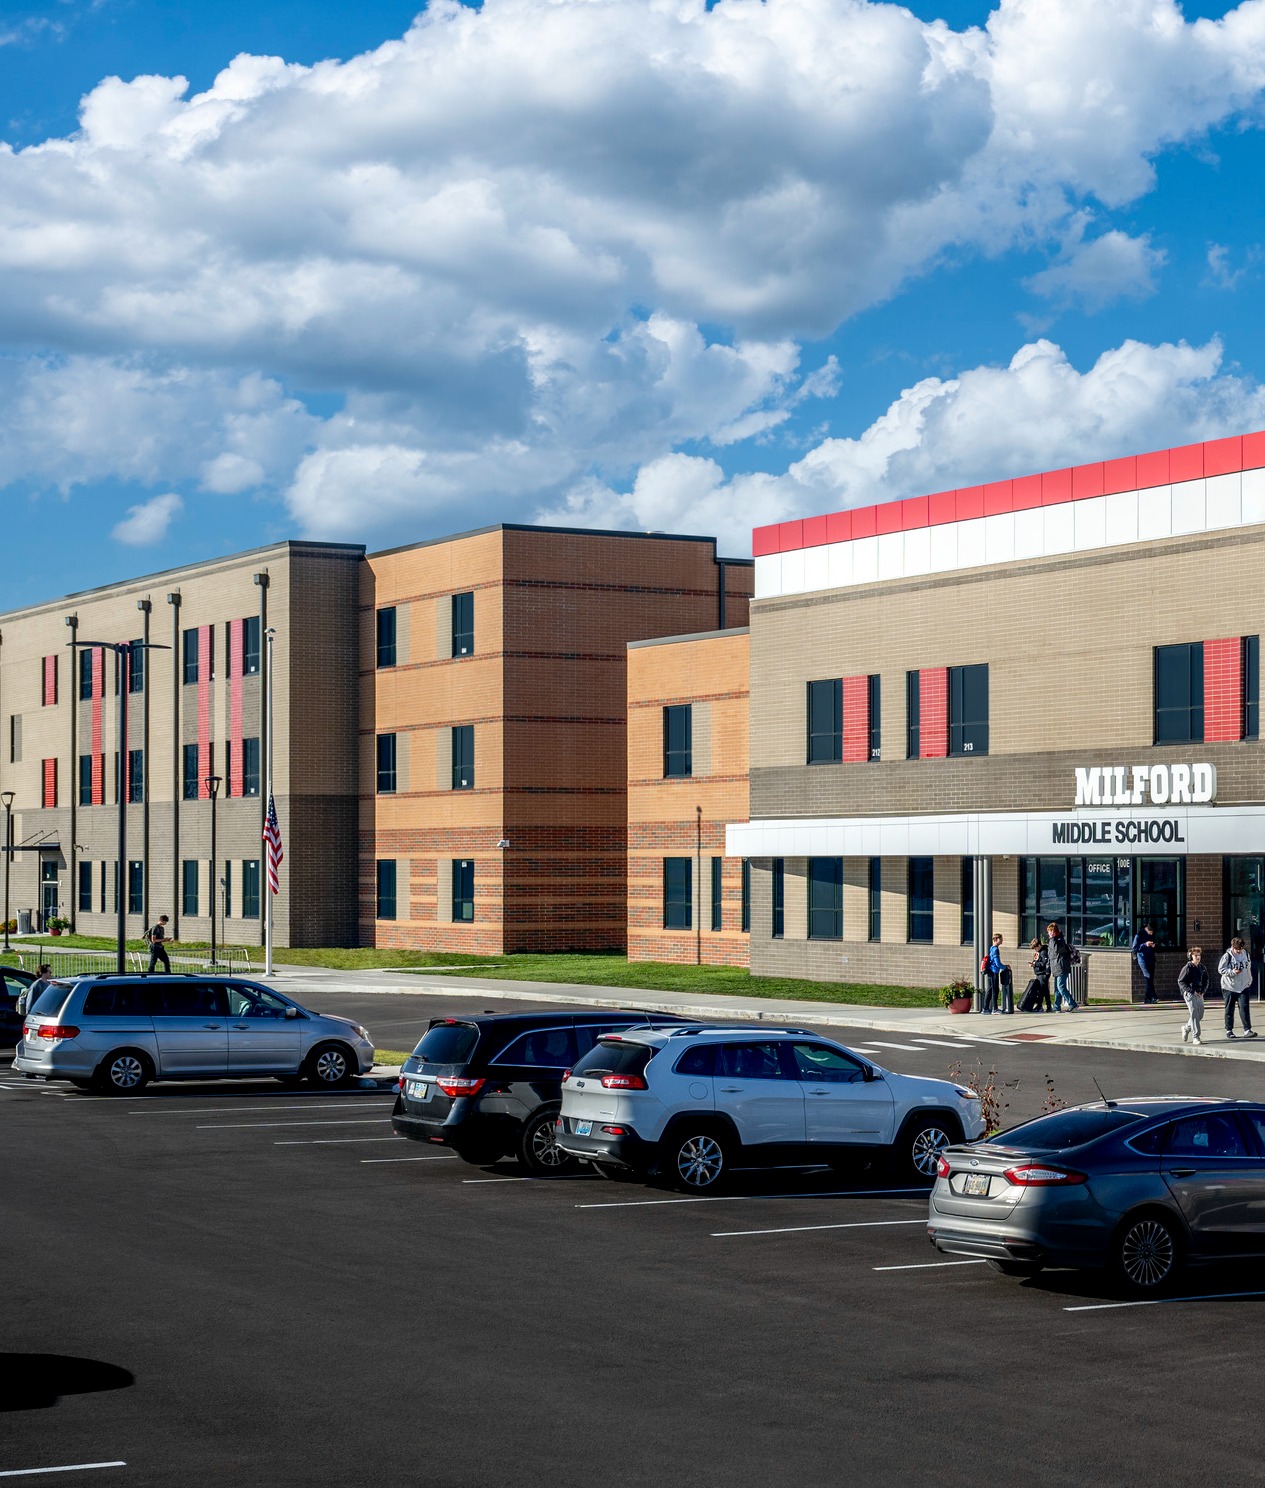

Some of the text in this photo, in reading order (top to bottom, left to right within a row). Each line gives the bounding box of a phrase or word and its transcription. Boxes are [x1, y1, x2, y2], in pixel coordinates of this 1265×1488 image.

[963, 743, 974, 751] 213
[1075, 763, 1214, 805] MILFORD
[1052, 820, 1185, 844] MIDDLE SCHOOL
[1117, 859, 1130, 868] 100E
[1088, 864, 1111, 873] OFFICE
